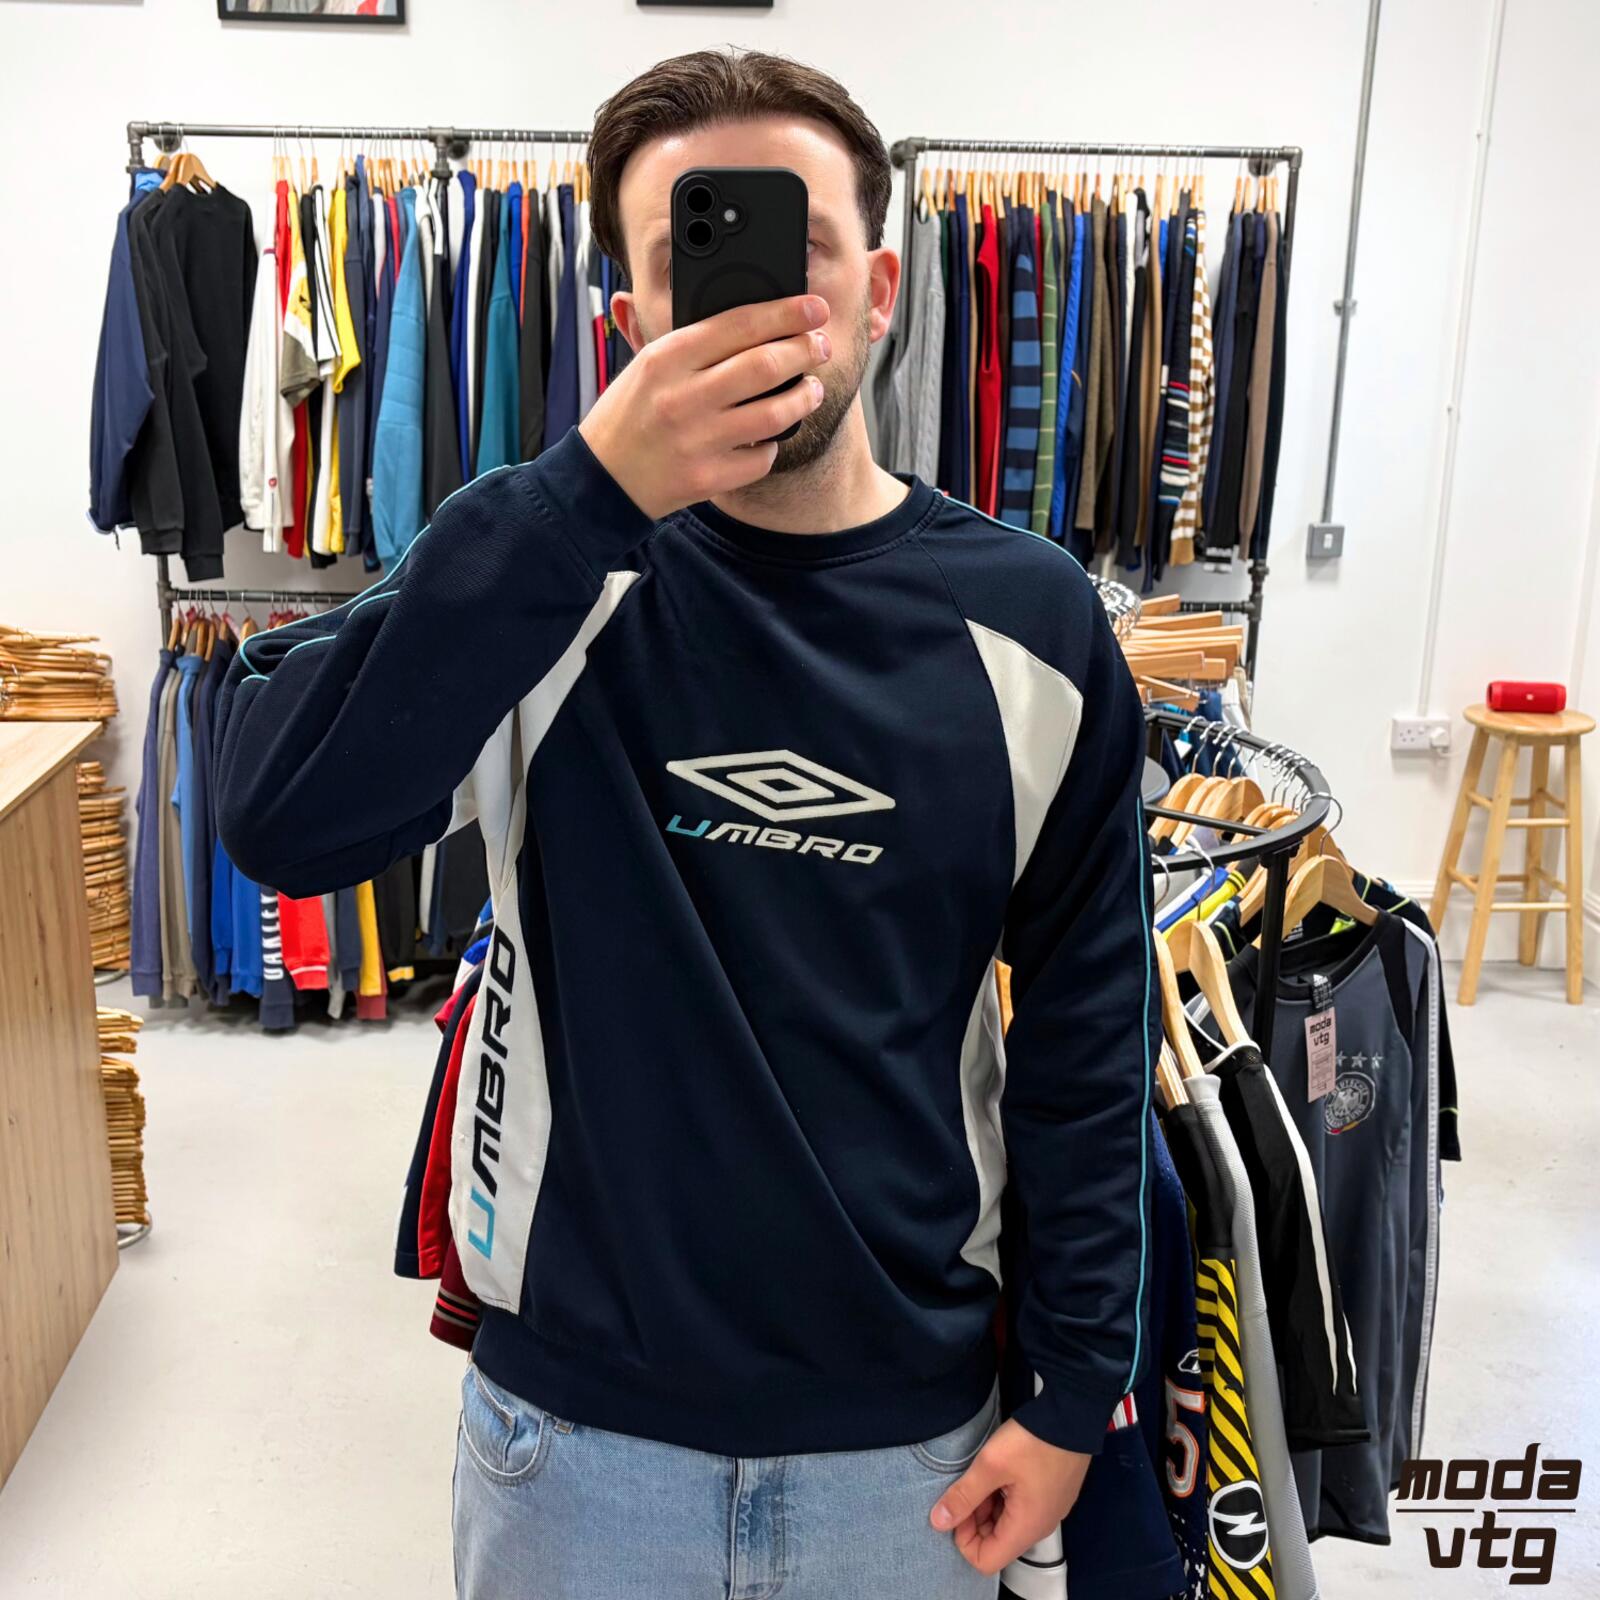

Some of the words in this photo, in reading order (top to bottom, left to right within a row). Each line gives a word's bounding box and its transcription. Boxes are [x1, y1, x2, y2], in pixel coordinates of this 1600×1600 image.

[666, 815, 883, 864] UMBRO
[1309, 1016, 1332, 1034] moda
[1313, 1032, 1330, 1047] vtg
[467, 924, 517, 1260] UMBRO
